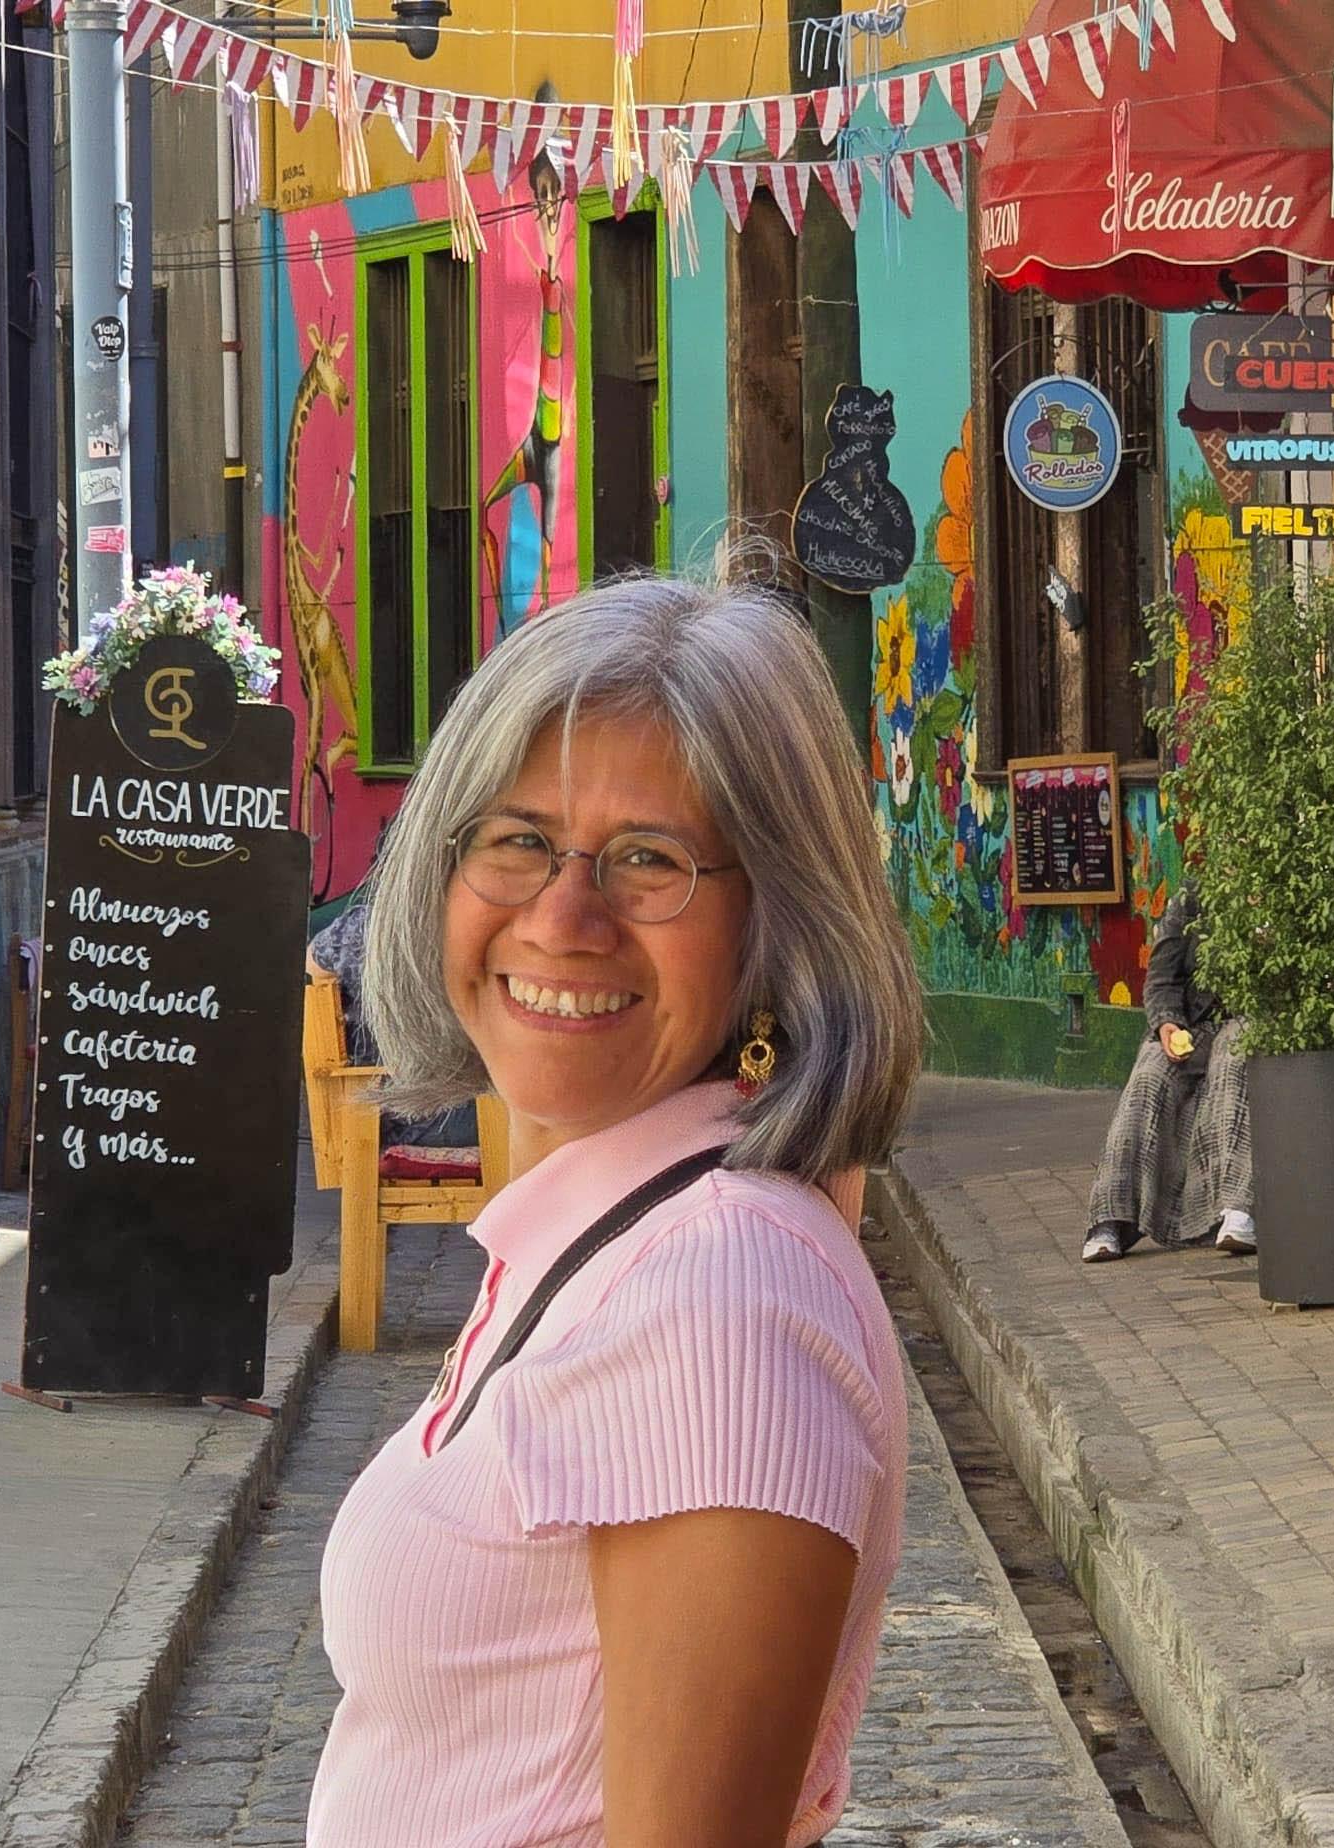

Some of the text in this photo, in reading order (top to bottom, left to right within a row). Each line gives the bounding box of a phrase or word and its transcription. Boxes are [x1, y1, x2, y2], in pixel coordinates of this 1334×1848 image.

[1100, 172, 1298, 235] Heladería
[1024, 459, 1104, 482] Rollados
[71, 773, 290, 831] LA CASA VERDE
[116, 827, 237, 852] restaurante
[69, 886, 211, 938] Almuerzos
[68, 936, 152, 971] Onces
[58, 1073, 161, 1122] Tragos
